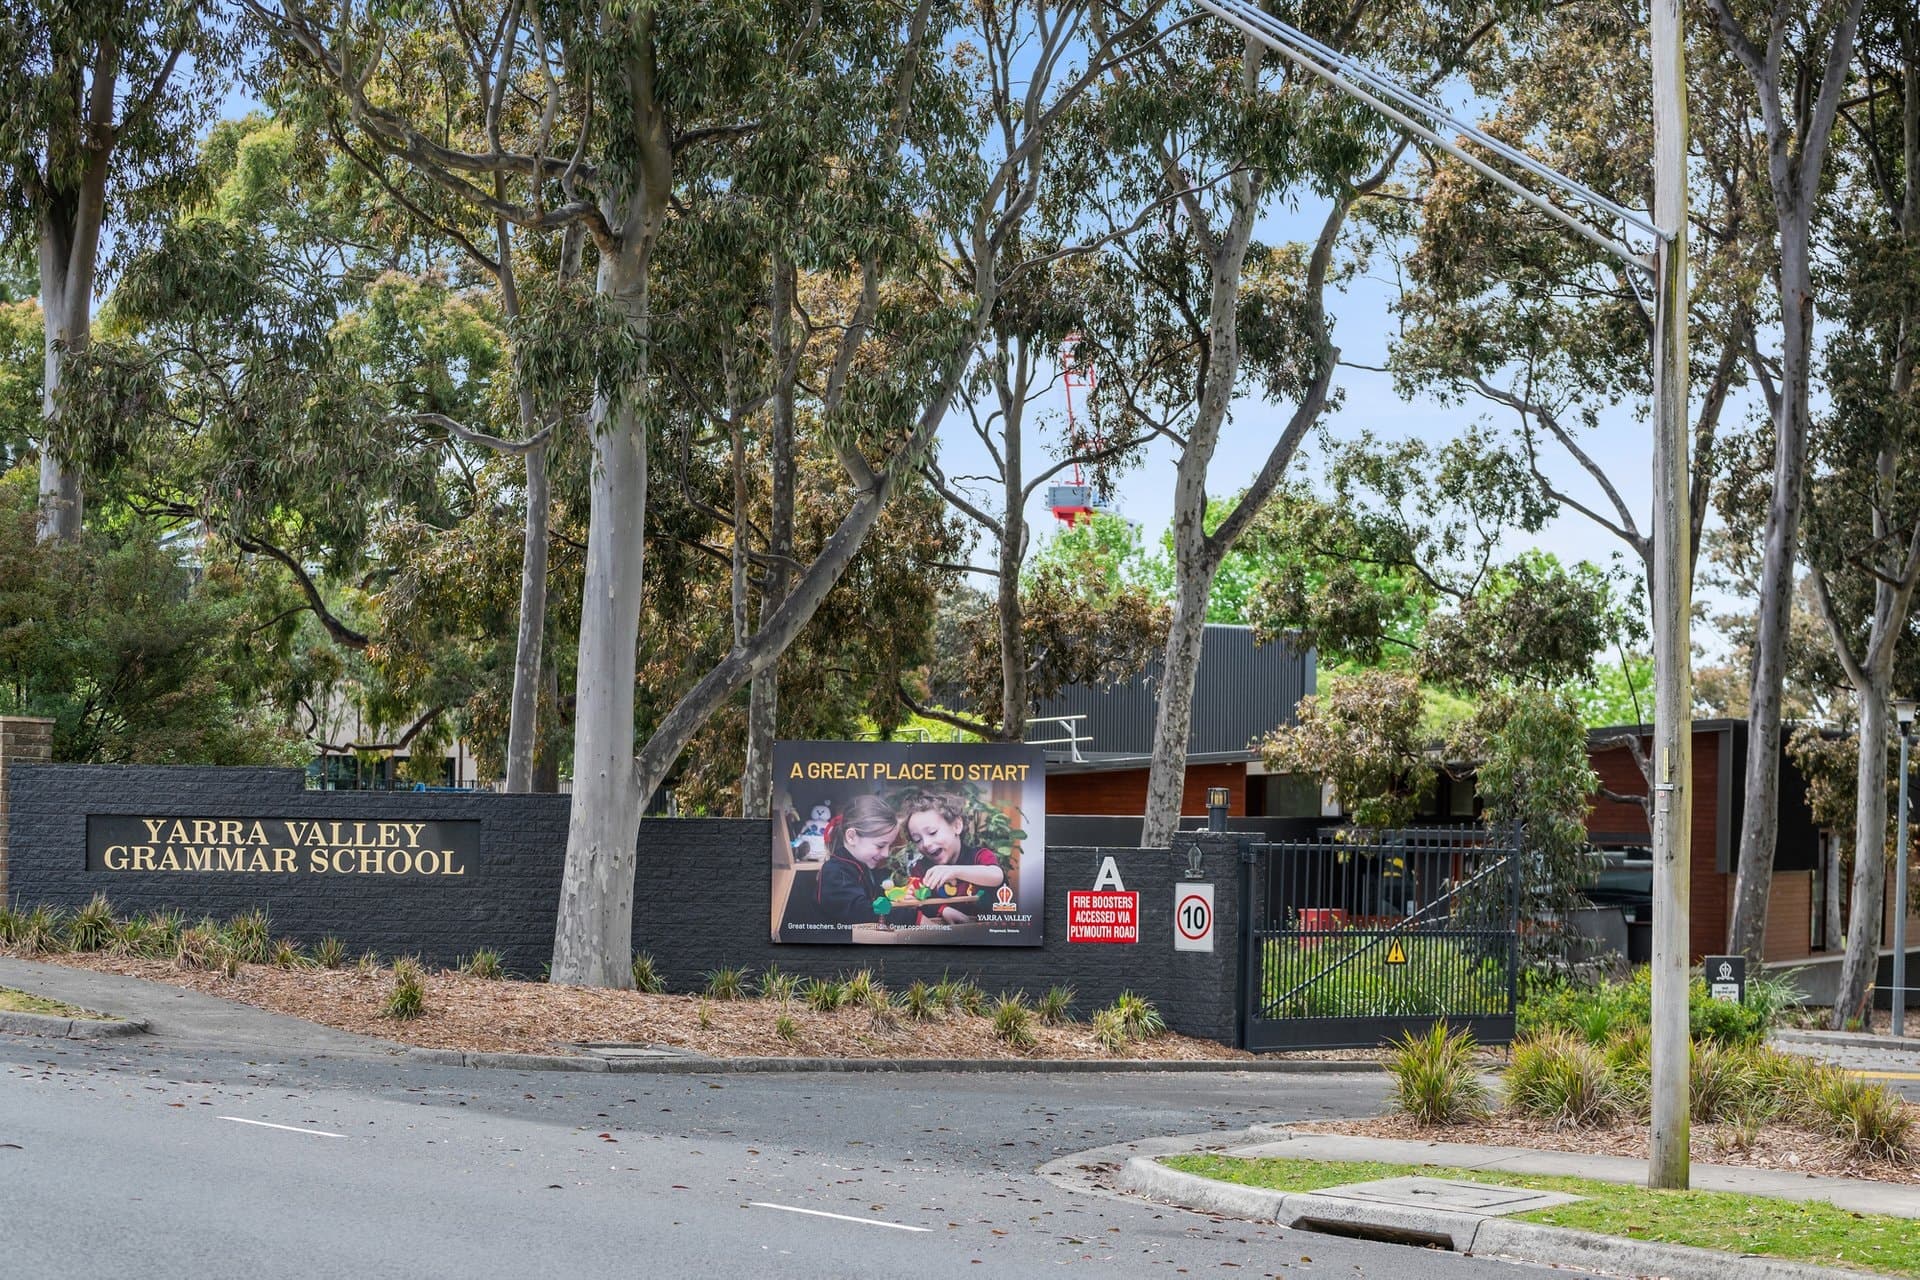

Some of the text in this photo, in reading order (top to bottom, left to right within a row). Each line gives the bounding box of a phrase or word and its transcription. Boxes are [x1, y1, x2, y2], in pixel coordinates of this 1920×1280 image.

[790, 762, 1030, 781] A GREAT PLACE TO START
[142, 819, 426, 848] YARRA VALLEY
[103, 845, 465, 875] GRAMMAR SCHOOL
[1093, 856, 1126, 891] A
[1073, 896, 1133, 909] FIRE BOOSTERS
[788, 922, 806, 930] Great
[806, 922, 836, 930] teachers.
[1075, 911, 1130, 923] ACCESSED VIA
[1183, 905, 1205, 929] 10
[1071, 925, 1135, 938] PLYMOUTH ROAD
